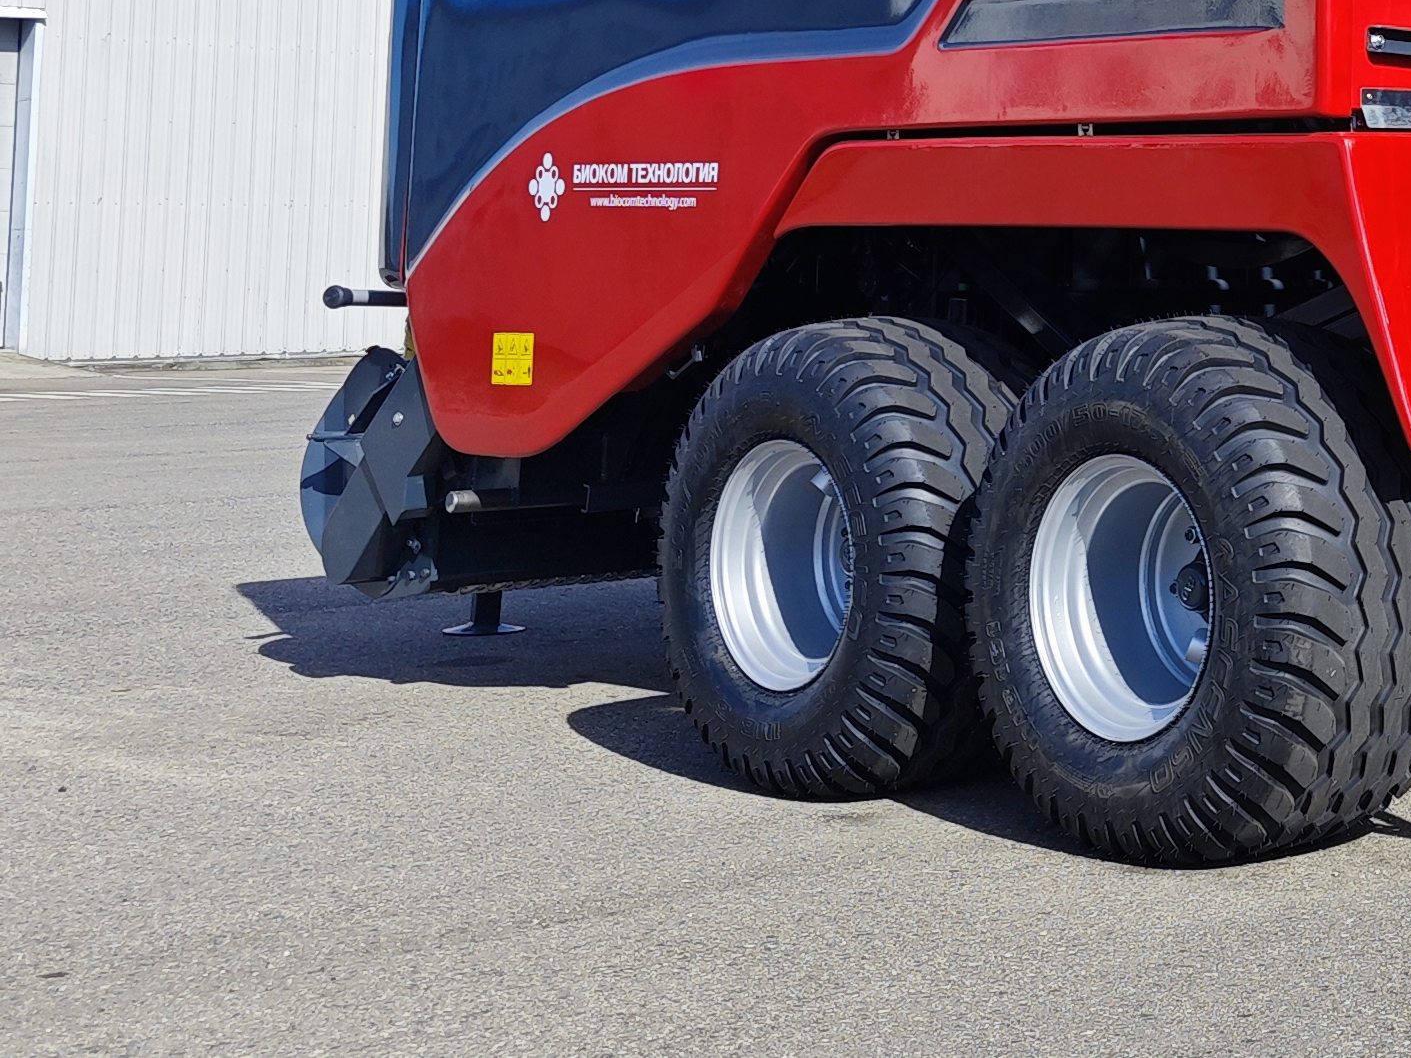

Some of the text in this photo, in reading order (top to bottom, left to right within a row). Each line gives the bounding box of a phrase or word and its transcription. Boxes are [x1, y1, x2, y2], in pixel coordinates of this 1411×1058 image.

[572, 162, 719, 184] БИОКОМ ТЕХНОЛОГИЯ
[590, 194, 697, 210] www.biocomtechnology.com
[1149, 571, 1240, 795] ASCENSO
